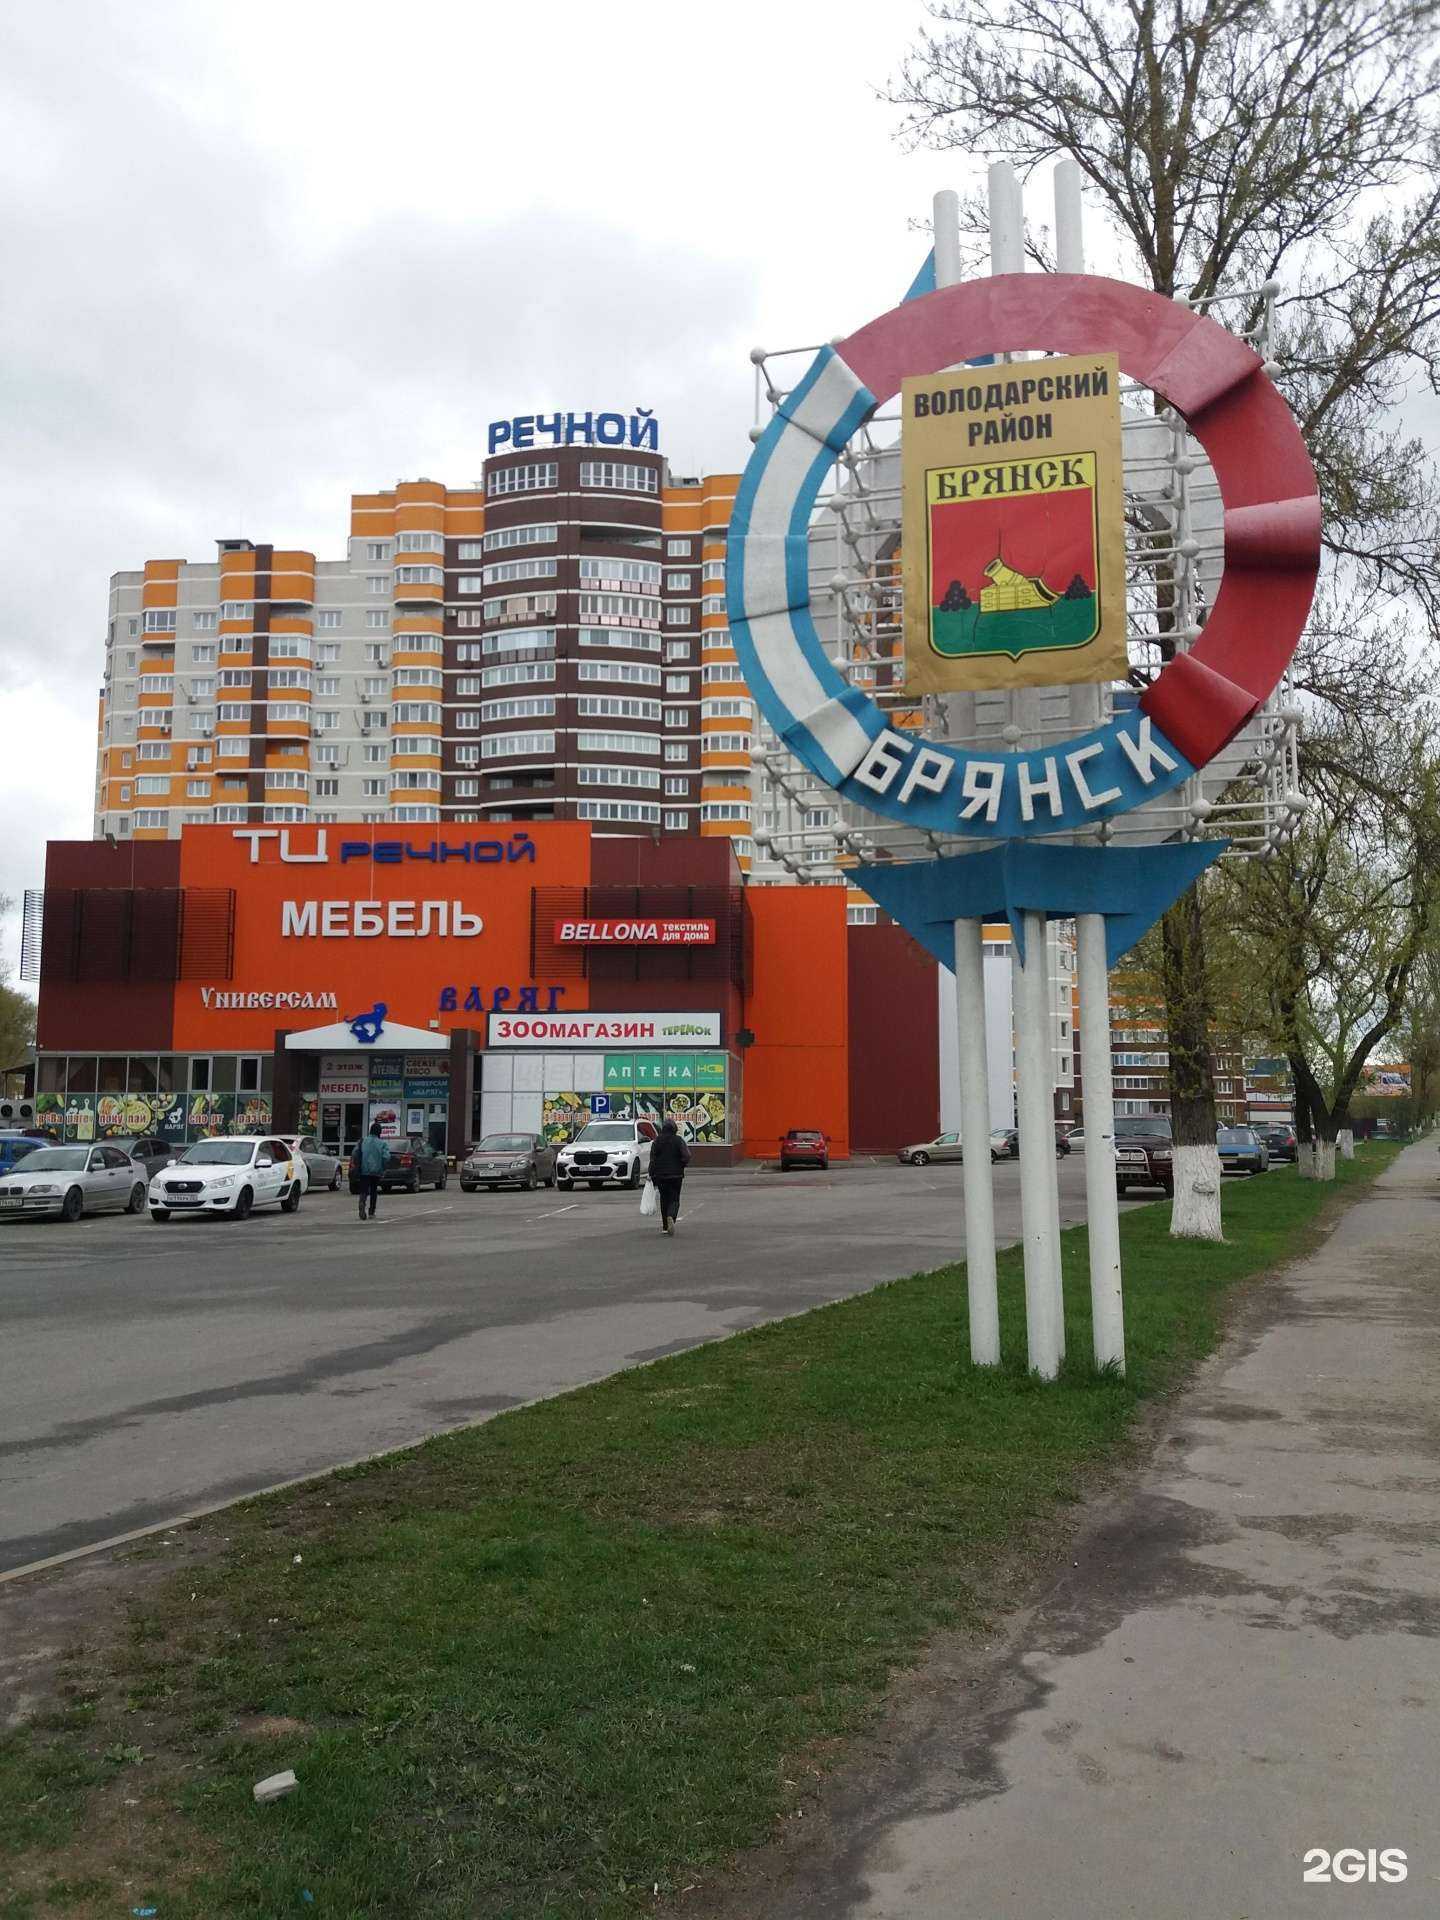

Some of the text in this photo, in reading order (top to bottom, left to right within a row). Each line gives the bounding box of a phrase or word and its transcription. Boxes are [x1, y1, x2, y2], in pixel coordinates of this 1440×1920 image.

[914, 366, 1108, 418] ВОЛОДАРСКИЙ
[488, 407, 659, 454] РЕЧНОЙ
[968, 412, 1052, 446] РАЙОН
[936, 457, 1087, 500] БРЯНСК
[854, 716, 1178, 821] БРЯНСК
[233, 829, 536, 863] ТЦ РЕЧНОЙ
[281, 900, 484, 937] МЕБЕЛЬ
[560, 923, 659, 940] BELLONA
[663, 923, 709, 931] текстиль
[662, 933, 680, 941] для
[439, 986, 566, 1011] ВАРЯГ
[497, 1021, 712, 1038] ЗООМАГАЗИН ТЕРЕМОК
[608, 1066, 693, 1077] АПТЕКА
[320, 1083, 367, 1094] МЕБЕЛЬ
